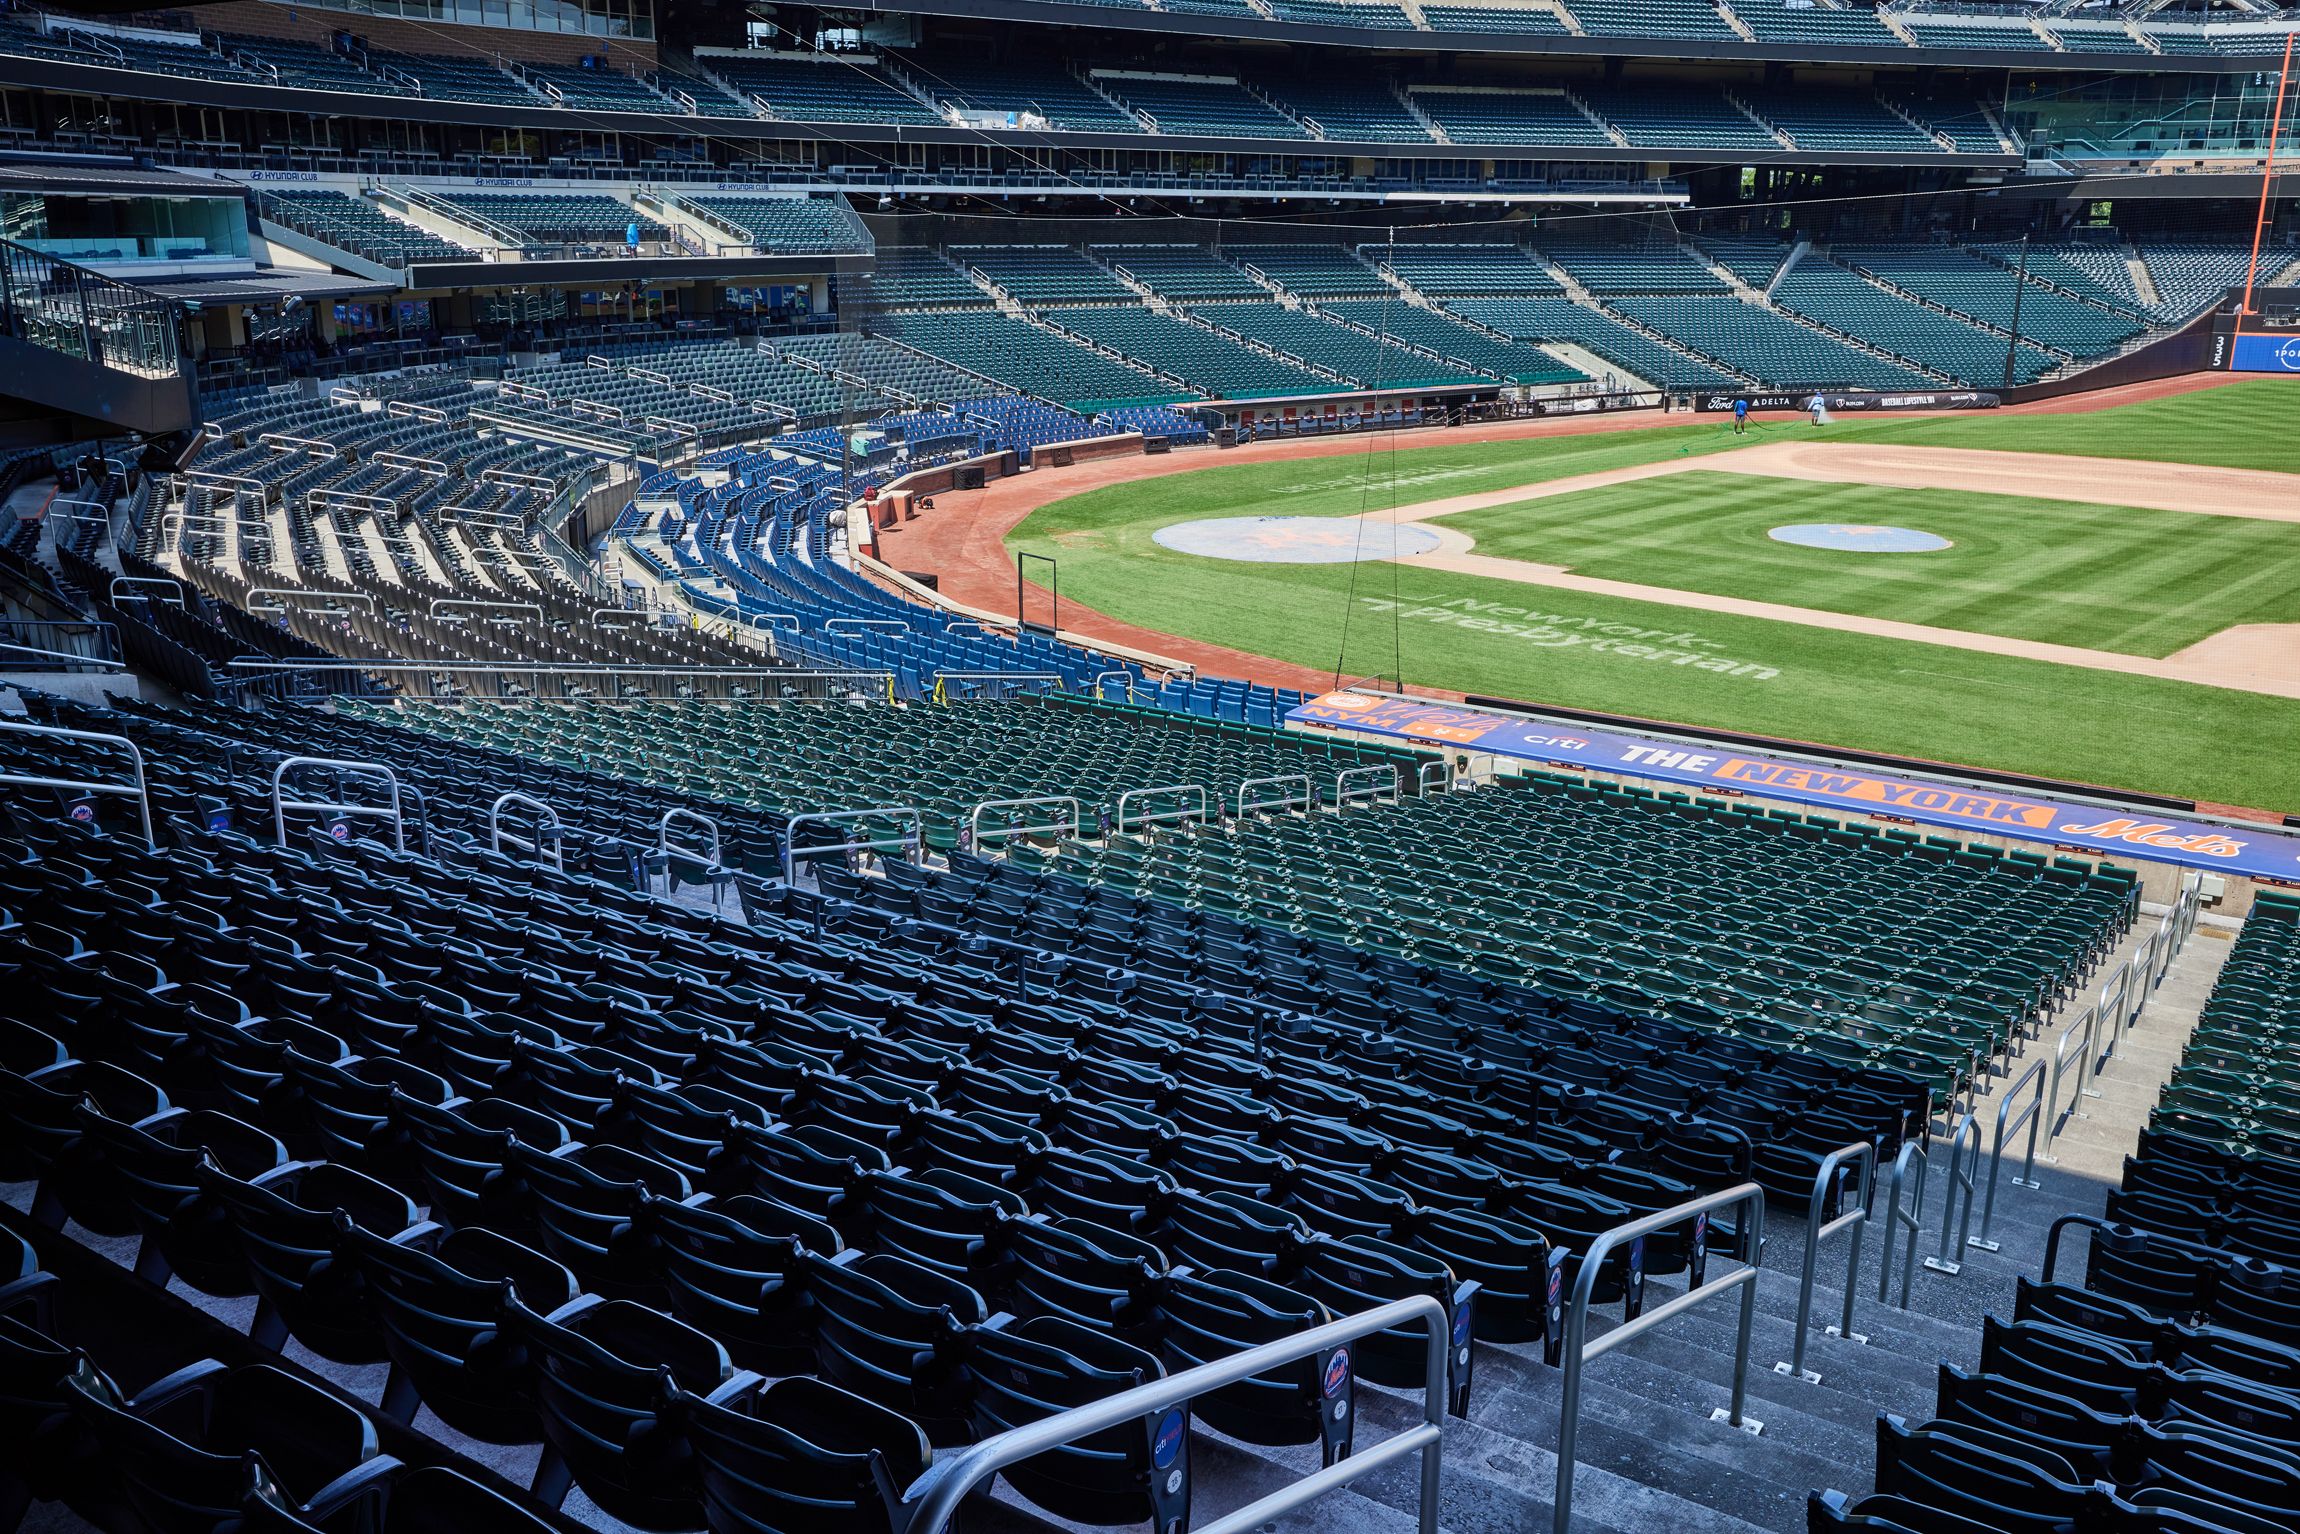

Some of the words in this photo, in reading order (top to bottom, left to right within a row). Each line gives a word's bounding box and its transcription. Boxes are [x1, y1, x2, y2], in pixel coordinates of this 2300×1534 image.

[265, 172, 299, 180] HYUNDAI
[301, 173, 318, 181] CLUB
[486, 178, 515, 186] HYUNDAI
[516, 179, 533, 187] CLUB
[2212, 336, 2225, 366] 335
[1708, 396, 1735, 410] Ford
[1761, 397, 1790, 406] DELTA
[1881, 397, 1904, 407] BASEBALL
[1400, 605, 1781, 680] Presbyterian
[1302, 706, 1391, 729] NYM
[1619, 744, 1718, 772] THE
[1733, 761, 1867, 794] NEW
[1880, 783, 2040, 825] YORK
[2059, 818, 2249, 858] Mets
